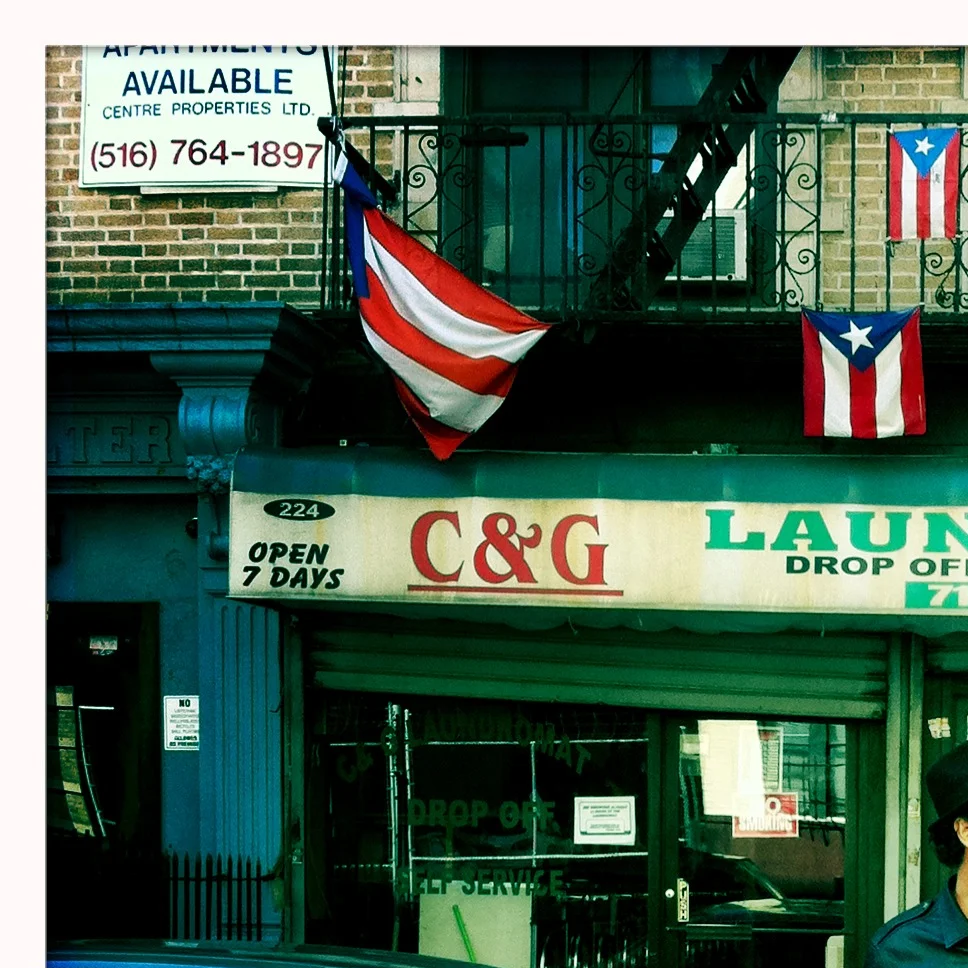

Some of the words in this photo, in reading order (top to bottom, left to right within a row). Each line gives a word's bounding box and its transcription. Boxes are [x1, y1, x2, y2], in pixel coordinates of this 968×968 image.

[123, 68, 293, 97] AVAILABLE
[102, 103, 161, 119] CENTRE
[171, 102, 271, 116] PROPERTIES
[282, 102, 314, 116] LTD.
[90, 141, 157, 171] (516)
[170, 139, 323, 169] 764-1897
[47, 414, 173, 463] TER
[279, 502, 320, 517] 224
[248, 541, 330, 565] OPEN
[410, 510, 610, 586] C&G
[242, 566, 258, 587] 7
[269, 567, 345, 590] DAYS
[786, 556, 895, 575] DROP
[179, 699, 190, 707] NO
[408, 800, 488, 828] DROP
[499, 800, 556, 829] OFF
[461, 868, 565, 898] SERVICE
